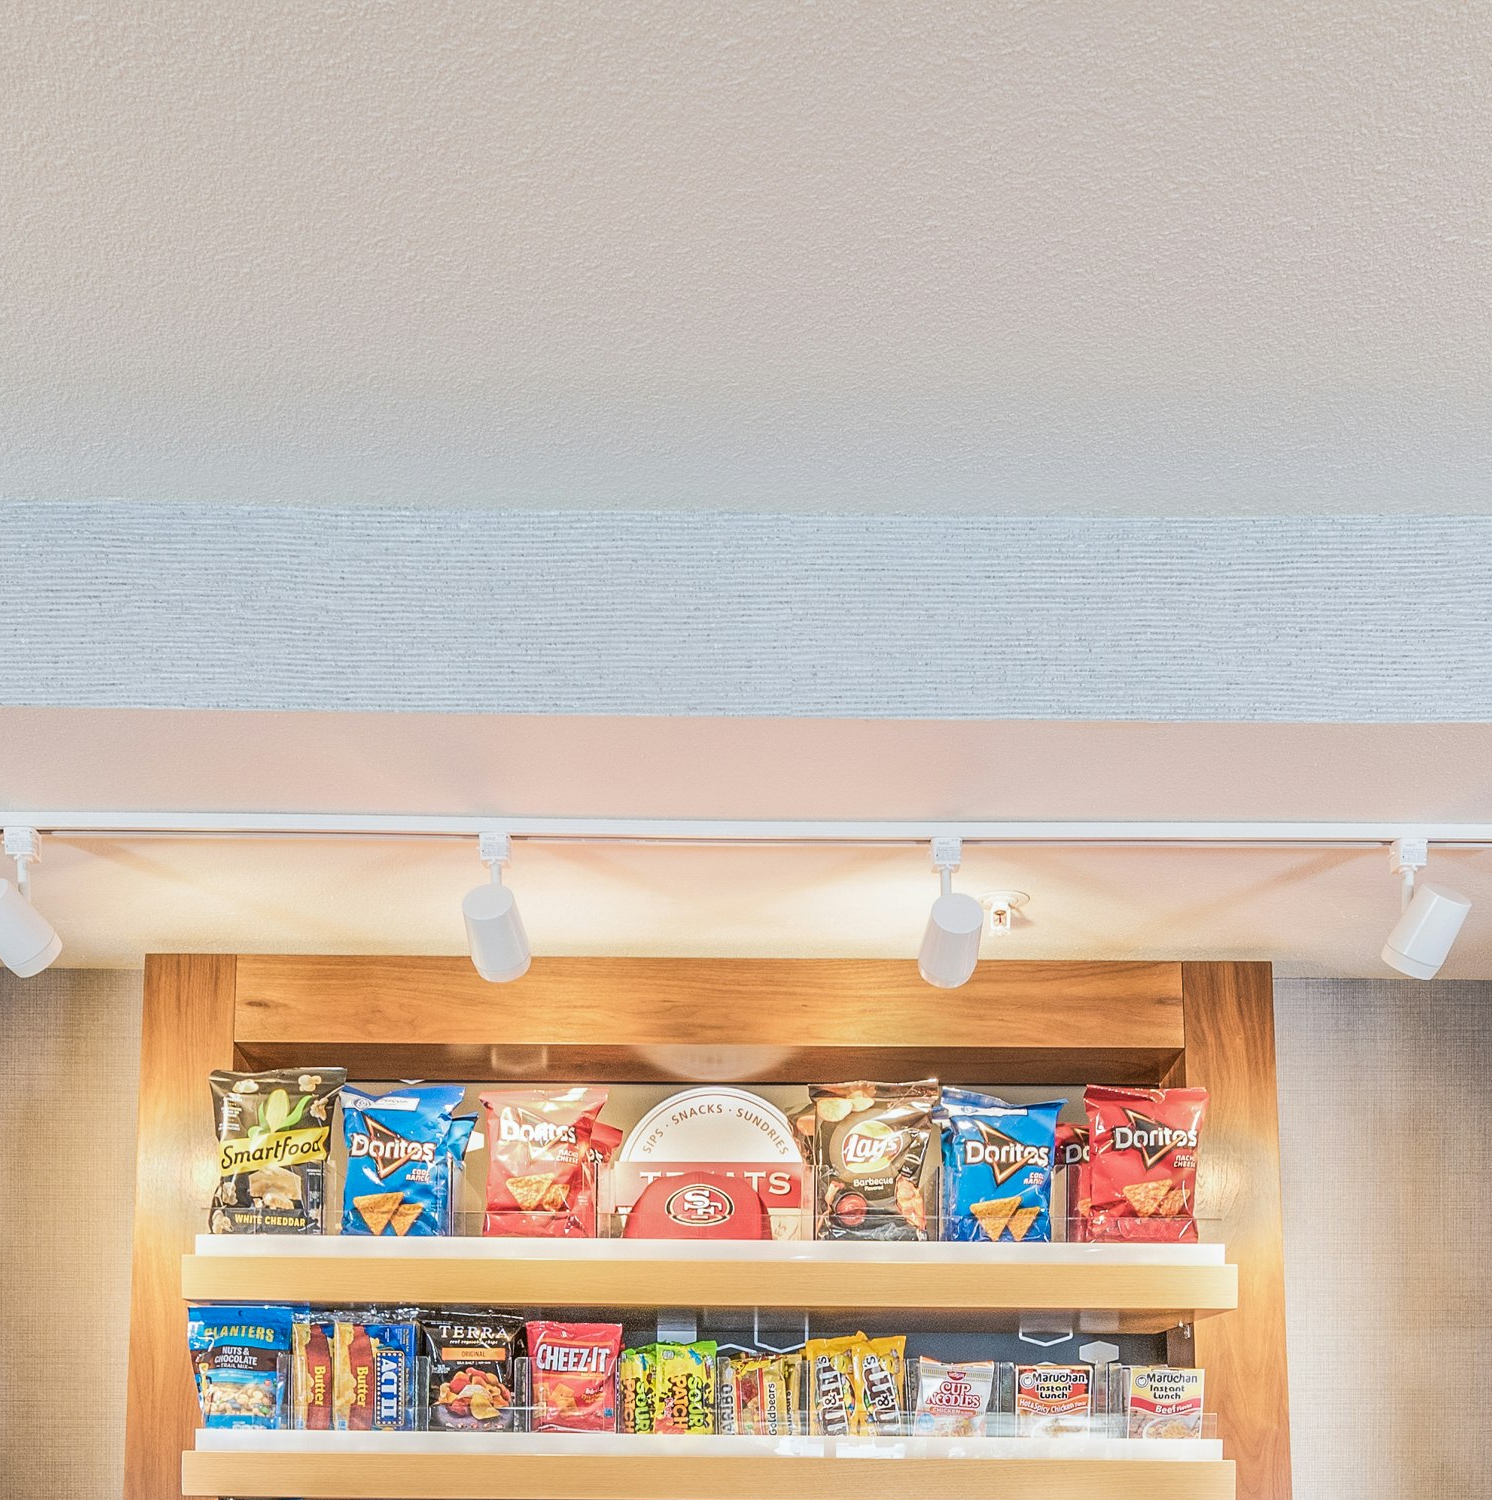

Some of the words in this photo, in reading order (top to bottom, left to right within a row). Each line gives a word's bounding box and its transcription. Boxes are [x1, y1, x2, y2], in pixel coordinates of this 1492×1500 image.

[500, 1118, 578, 1145] Doritos
[643, 1128, 664, 1154] SIPS
[671, 1104, 723, 1125] SNACKS
[736, 1108, 789, 1156] SUNDRIES
[1114, 1125, 1197, 1149] Doritos
[221, 1136, 321, 1167] Smartfood
[350, 1135, 436, 1161] Doritos
[965, 1139, 1049, 1166] Doritos
[853, 1176, 894, 1186] Barbecue
[234, 1214, 262, 1226] WHITE
[264, 1216, 306, 1228] CHEDDAR
[204, 1326, 275, 1342] PLANTERS
[215, 1355, 257, 1366] CHOCOLATE
[222, 1346, 242, 1356] NUTS
[243, 1347, 250, 1355] &
[536, 1343, 610, 1372] CHEEZ-IT
[313, 1366, 325, 1406] Butter
[357, 1366, 369, 1407] Butter
[940, 1381, 971, 1395] CUP
[1033, 1373, 1087, 1383] Maruchan
[1147, 1373, 1197, 1383] Maruchan
[623, 1379, 635, 1433] PATCH
[635, 1381, 650, 1431] SOUR
[670, 1375, 688, 1429] PATCH
[688, 1376, 704, 1427] SOUR
[721, 1384, 734, 1435] ARIBO
[769, 1383, 777, 1435] Goldbears
[926, 1392, 981, 1408] NOODLES
[1050, 1402, 1074, 1413] Chicken
[1155, 1405, 1176, 1413] Beef
